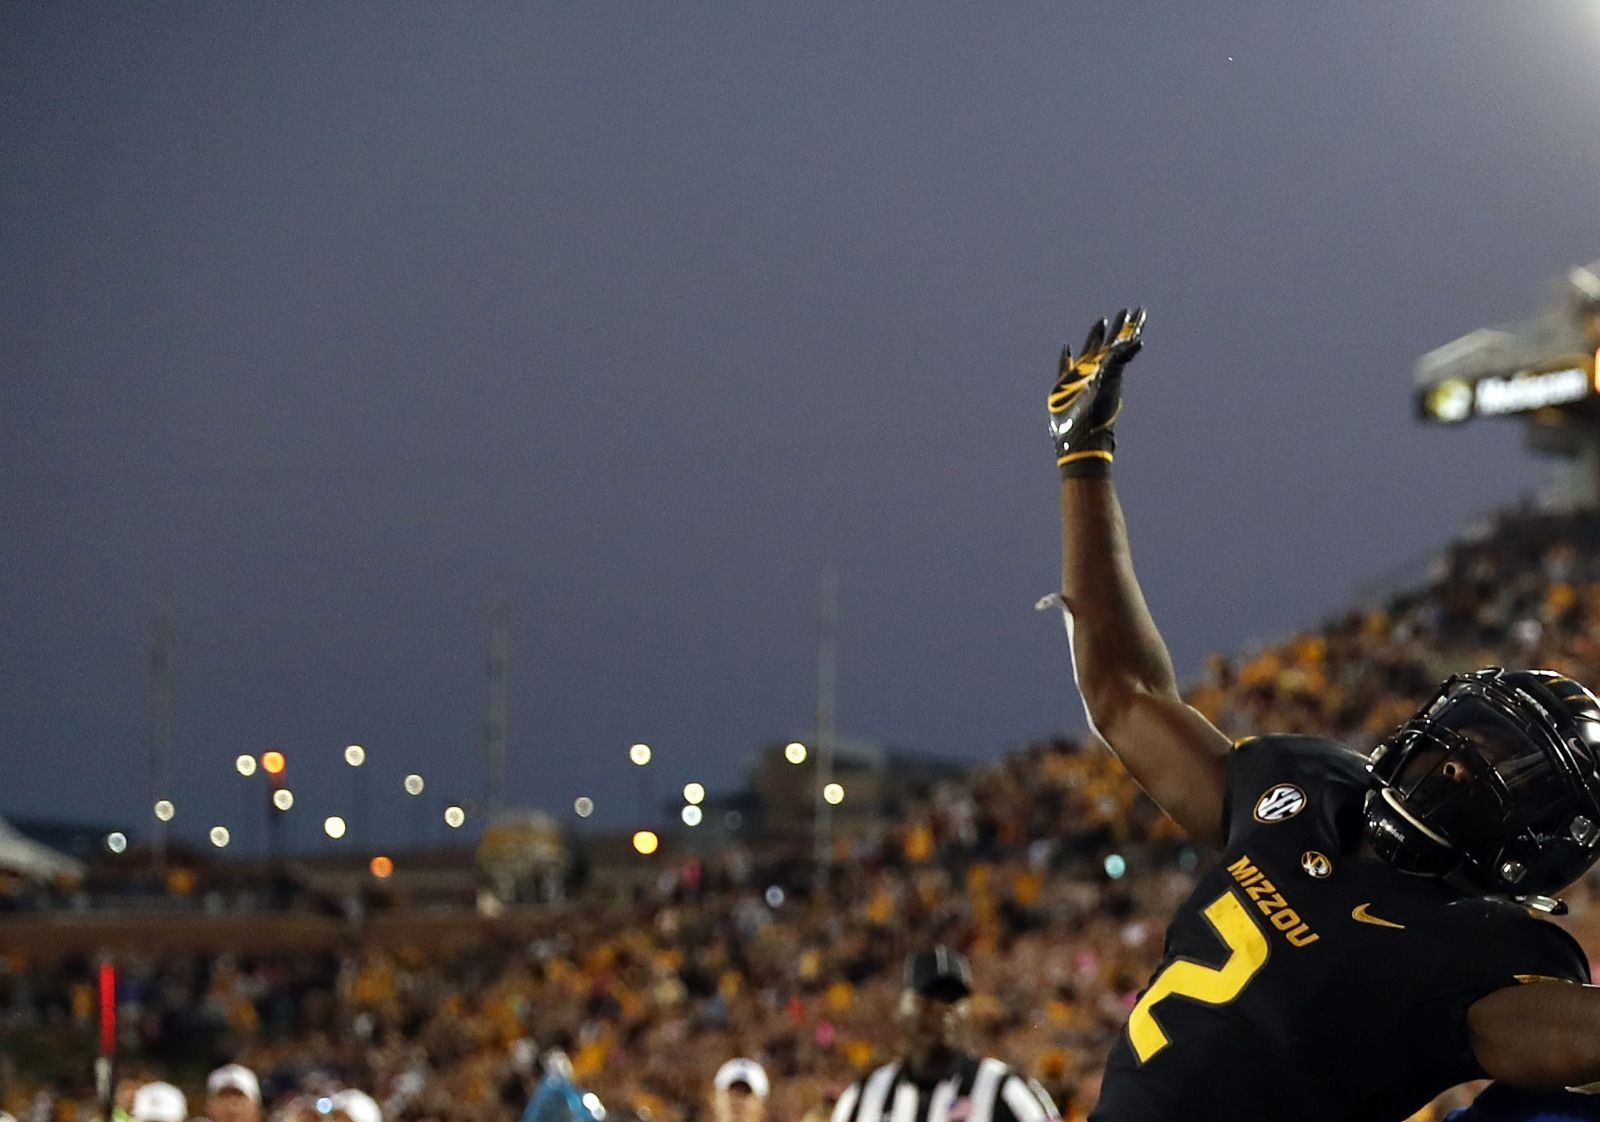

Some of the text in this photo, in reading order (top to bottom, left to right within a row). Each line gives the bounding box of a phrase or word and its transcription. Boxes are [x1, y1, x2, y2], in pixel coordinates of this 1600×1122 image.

[1256, 786, 1304, 822] SEC
[1226, 855, 1320, 948] MIZZOU
[1129, 890, 1269, 1063] 2
